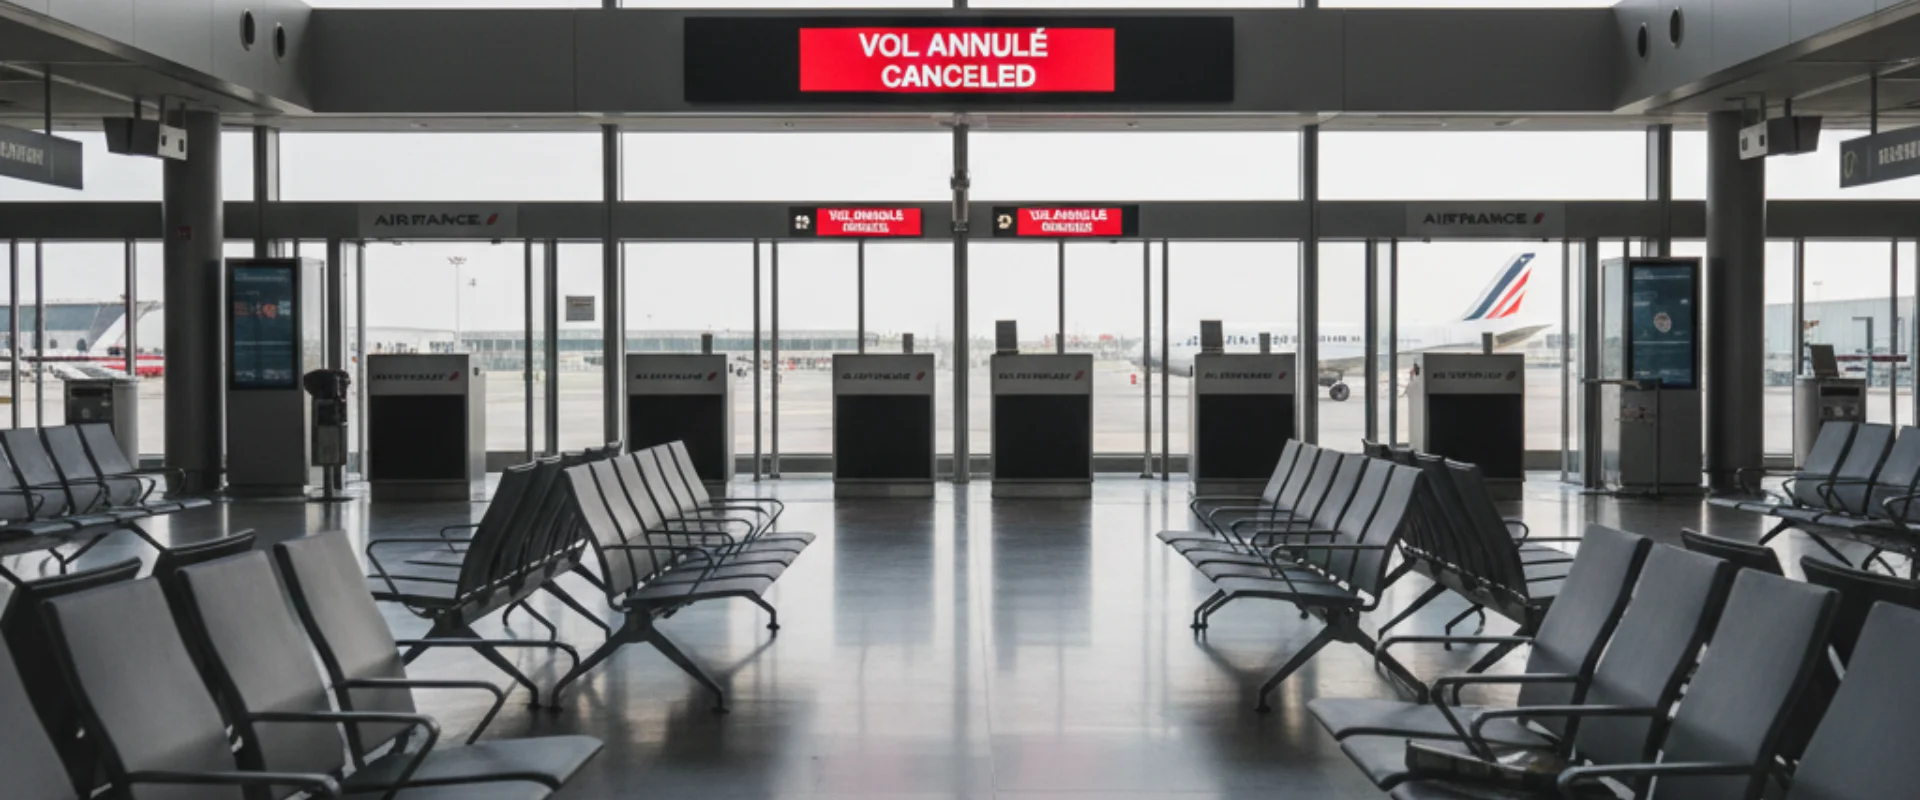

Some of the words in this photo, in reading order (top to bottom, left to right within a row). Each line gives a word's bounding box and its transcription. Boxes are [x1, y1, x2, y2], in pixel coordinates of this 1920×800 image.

[858, 33, 920, 57] VOL
[926, 27, 1048, 57] ANNULÉ
[881, 64, 1036, 88] CANCELED
